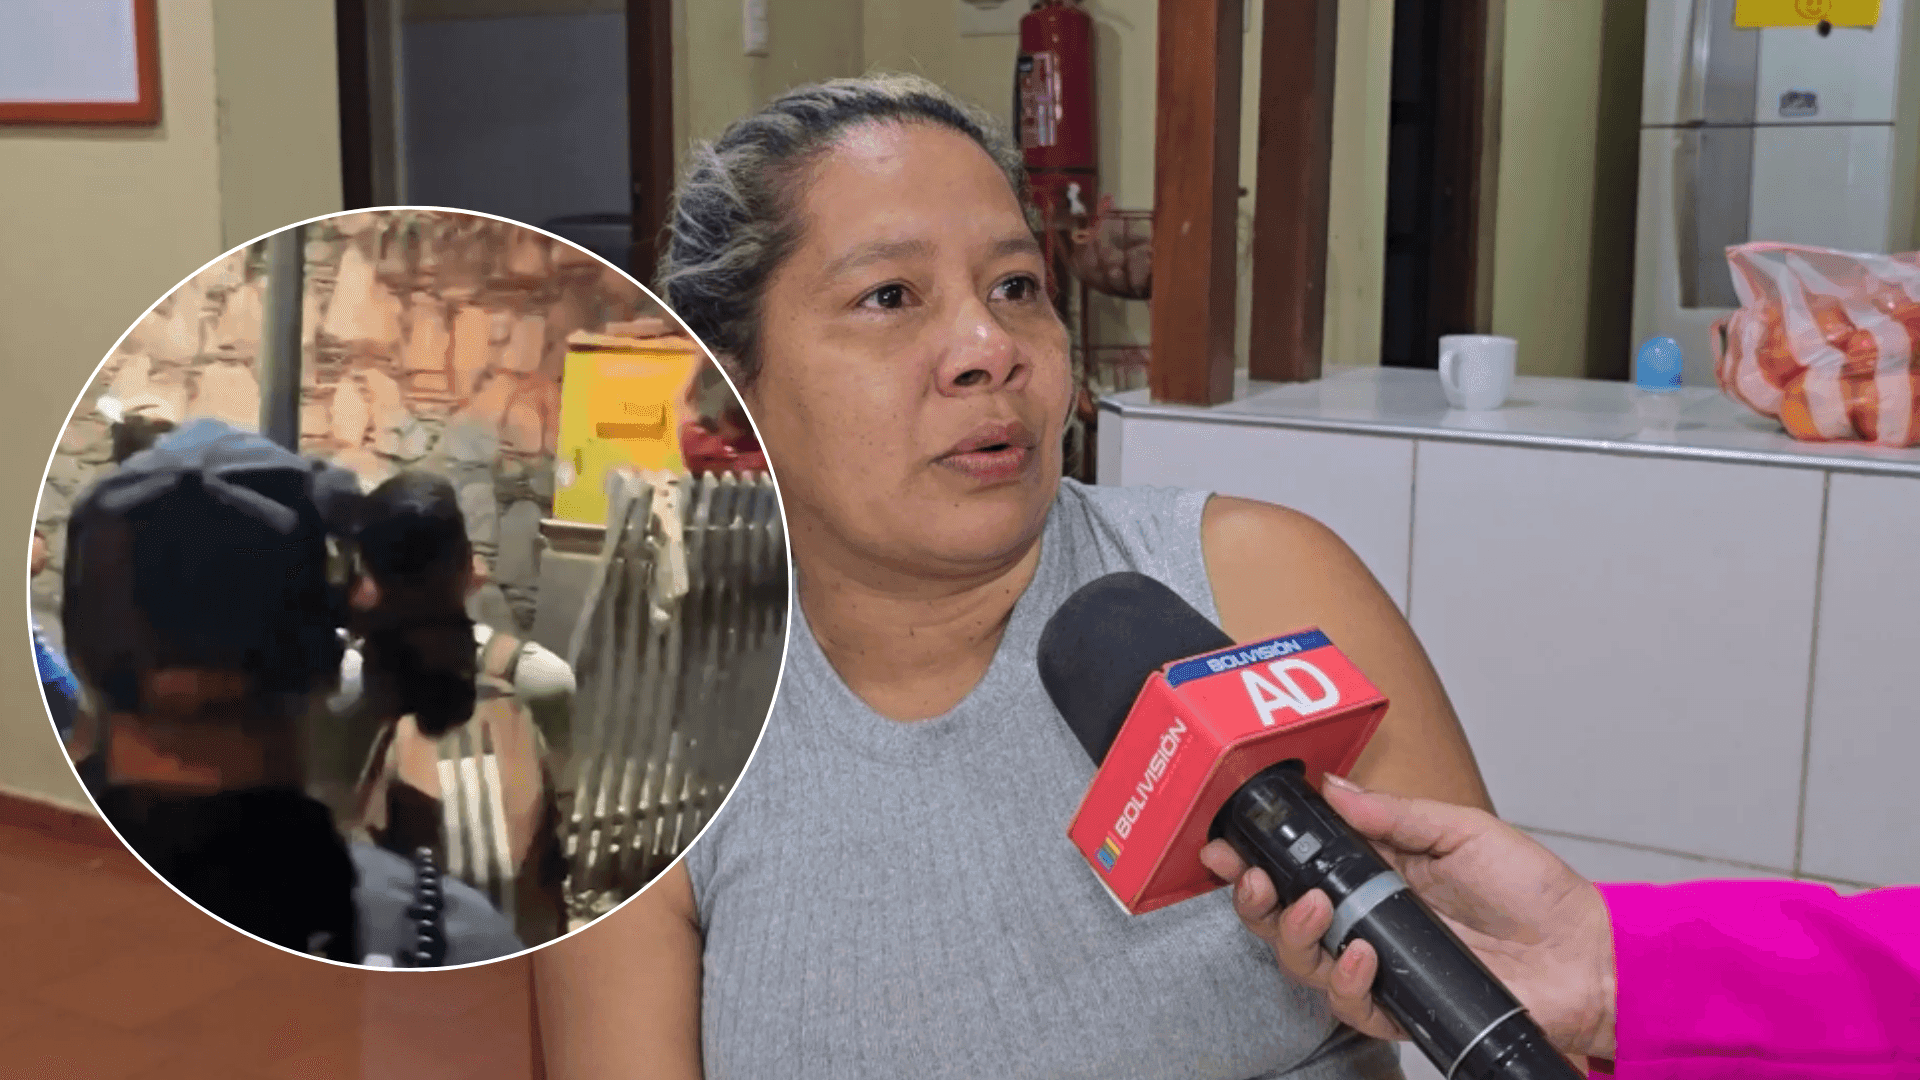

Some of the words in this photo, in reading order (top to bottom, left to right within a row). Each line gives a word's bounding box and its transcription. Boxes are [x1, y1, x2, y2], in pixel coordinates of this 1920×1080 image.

[1206, 639, 1302, 672] BOLIVISIÓN
[1240, 658, 1340, 727] AD
[1114, 716, 1187, 840] BOLIVISIÓN
